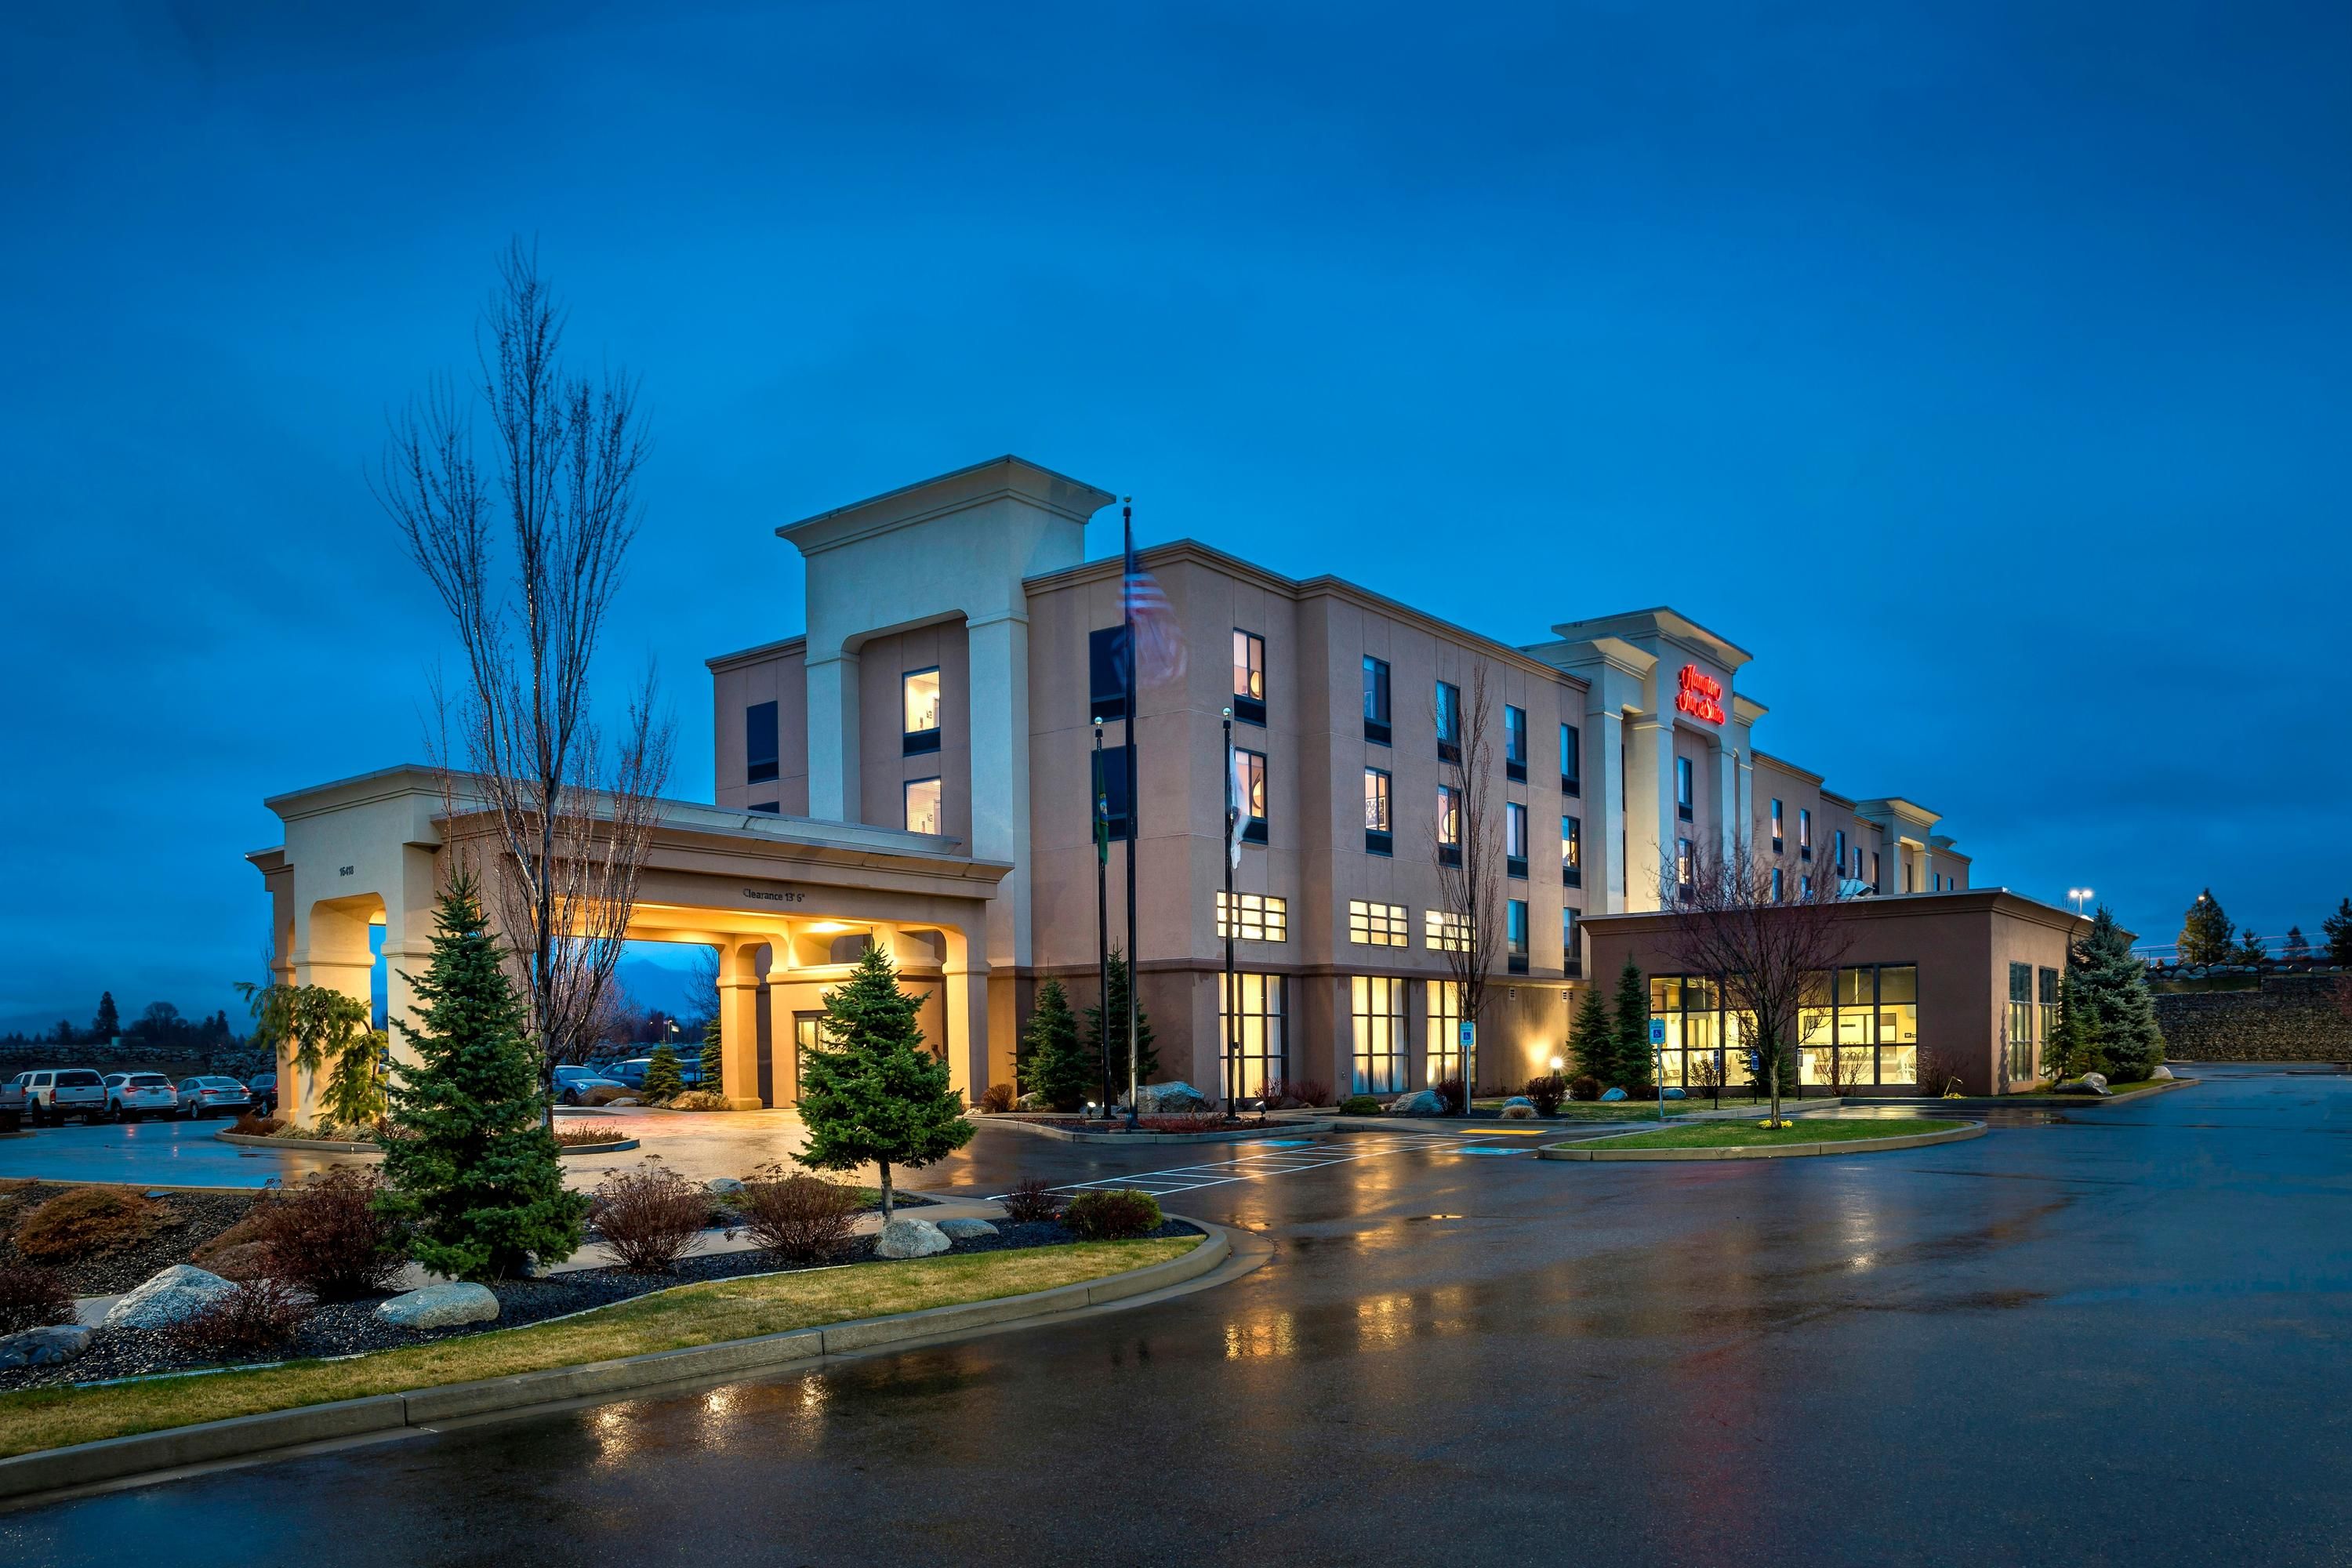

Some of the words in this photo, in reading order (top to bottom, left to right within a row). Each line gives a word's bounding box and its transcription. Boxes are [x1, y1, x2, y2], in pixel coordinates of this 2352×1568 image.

[1680, 664, 1722, 701] Hampton
[1676, 690, 1700, 716] Inn
[1704, 698, 1725, 725] Suites
[743, 888, 783, 901] Clearance
